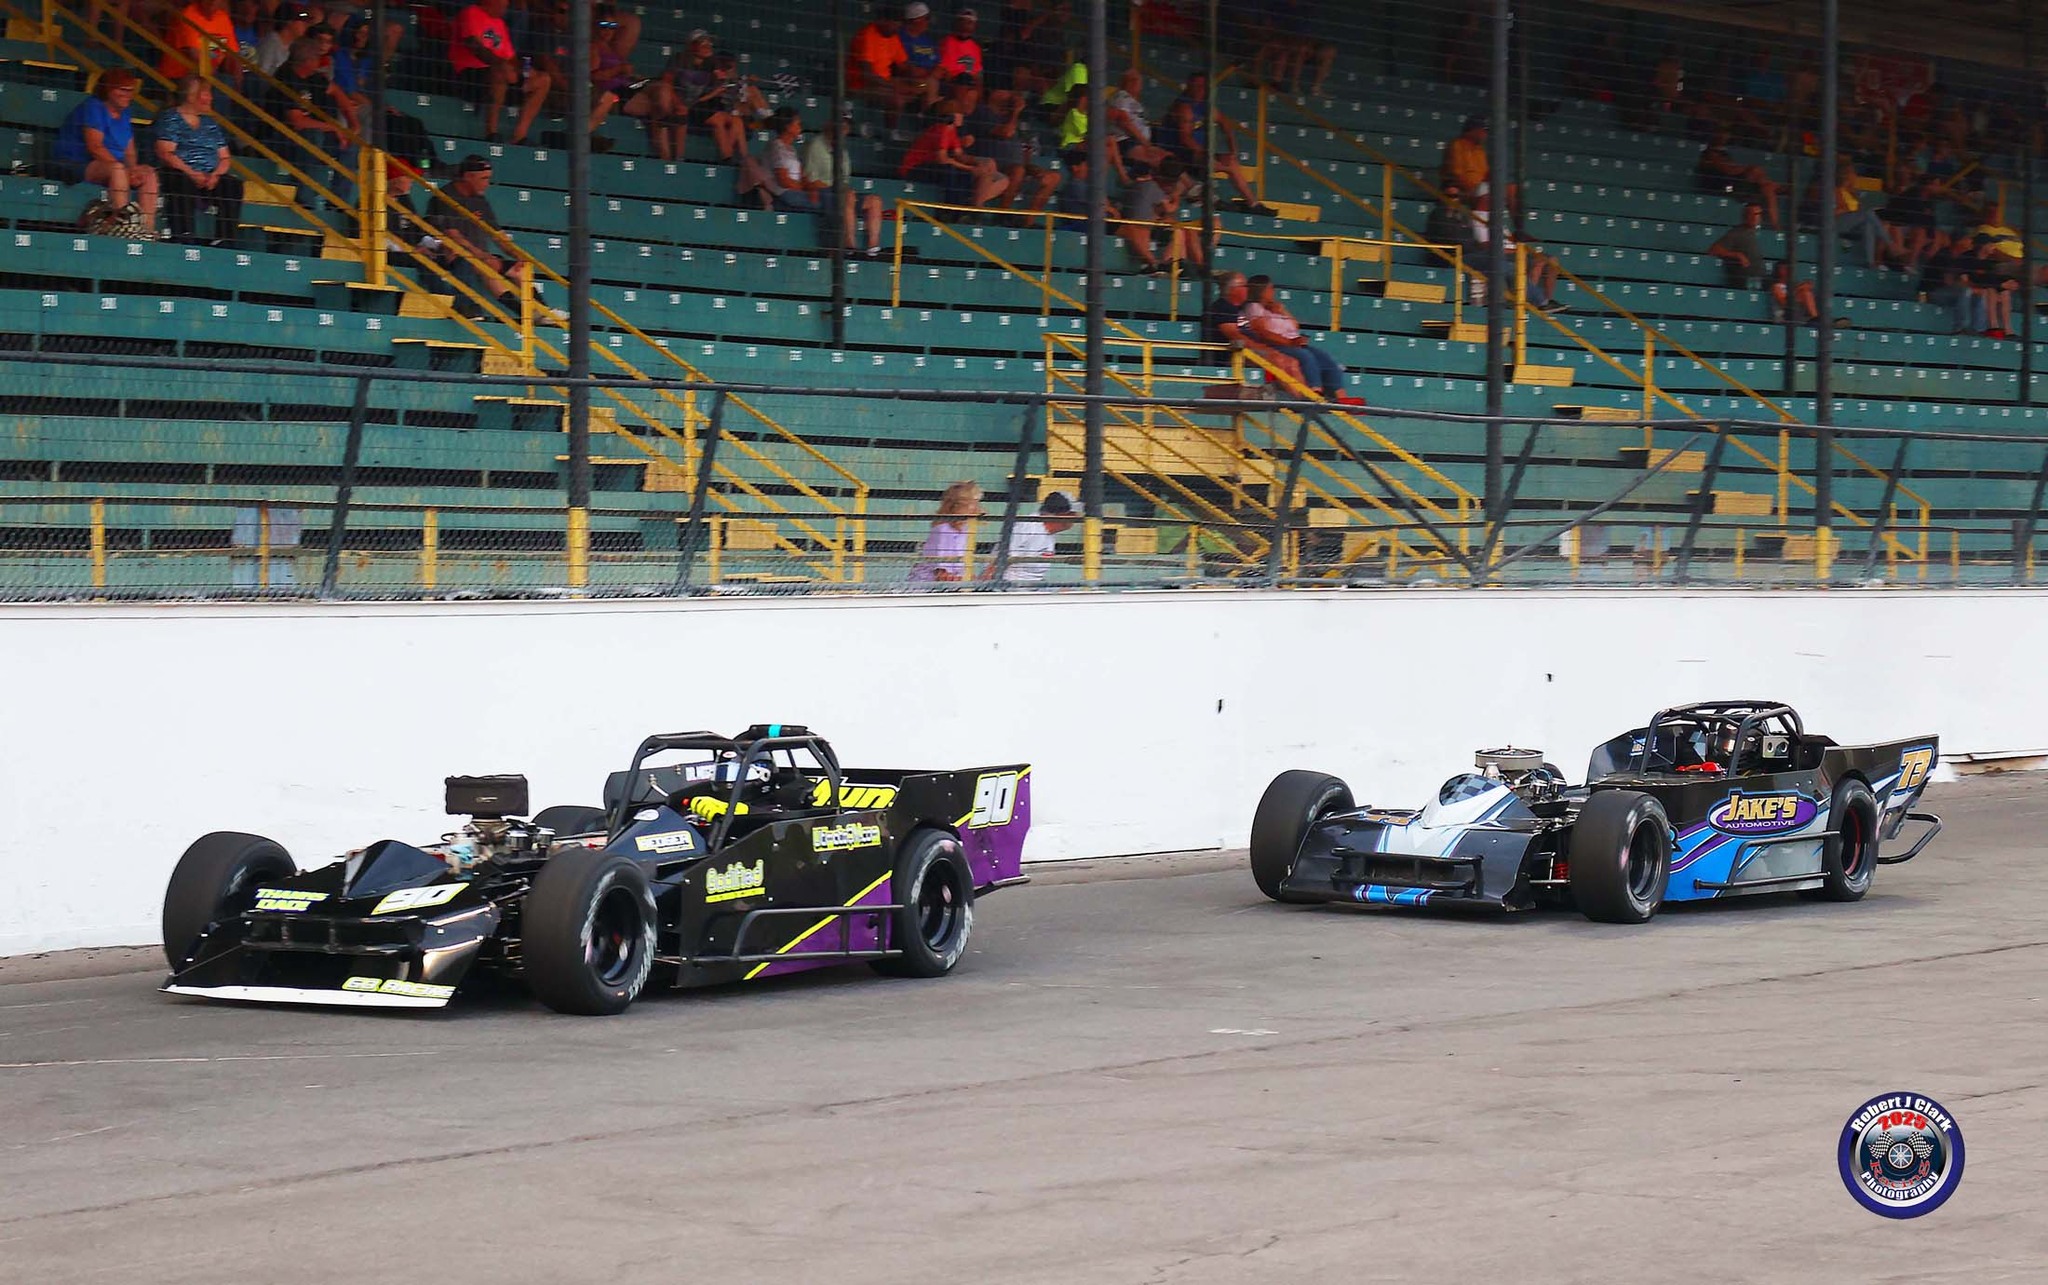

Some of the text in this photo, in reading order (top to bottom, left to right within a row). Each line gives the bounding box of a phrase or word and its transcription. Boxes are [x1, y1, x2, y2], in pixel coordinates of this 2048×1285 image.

[1897, 748, 1933, 789] 73
[968, 771, 1018, 829] 90
[1722, 794, 1798, 821] JAKE'S
[1725, 820, 1796, 829] AUTOMOTIVE
[370, 882, 470, 915] 90
